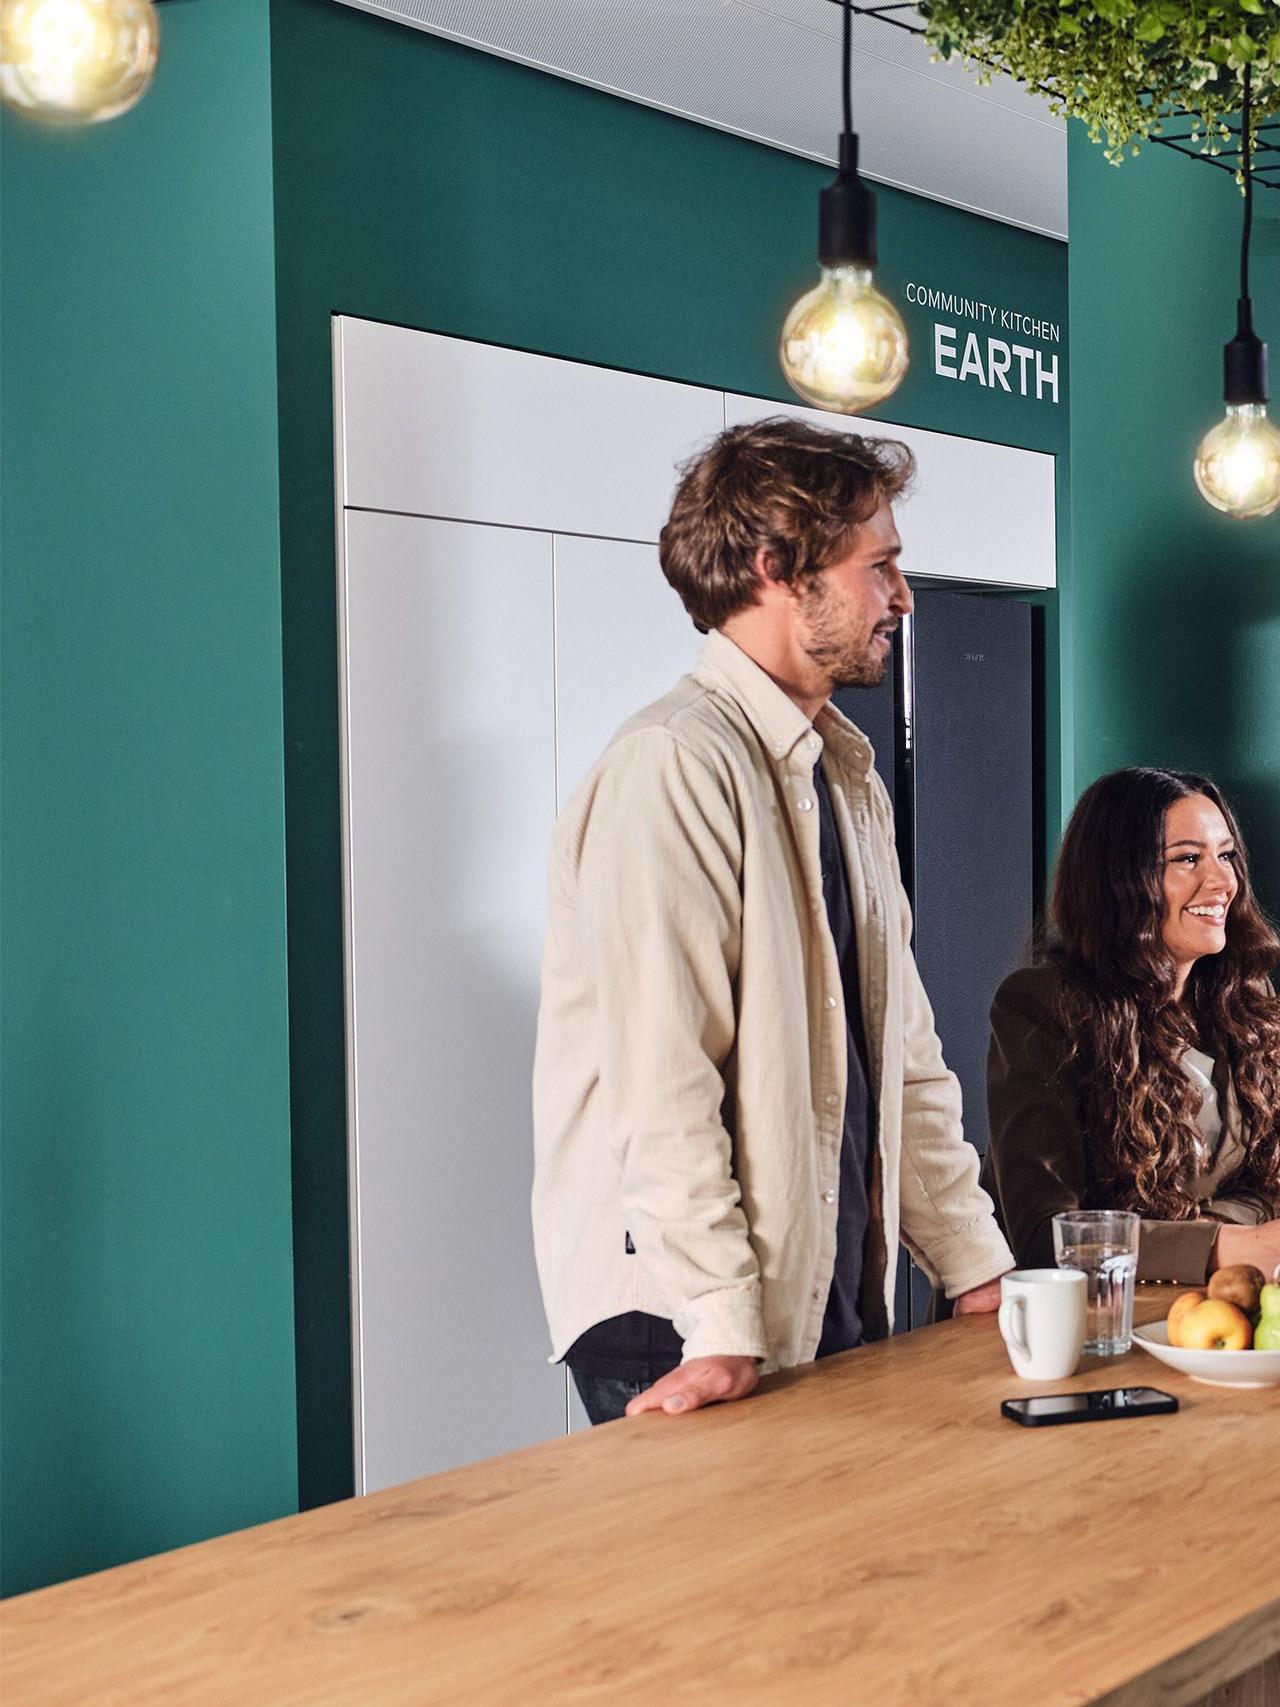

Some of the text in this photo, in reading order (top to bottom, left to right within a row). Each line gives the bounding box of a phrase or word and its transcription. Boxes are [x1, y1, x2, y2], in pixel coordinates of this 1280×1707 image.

[906, 283, 1060, 343] COMMUNITY KITCHEN
[934, 323, 1059, 404] EARTH
